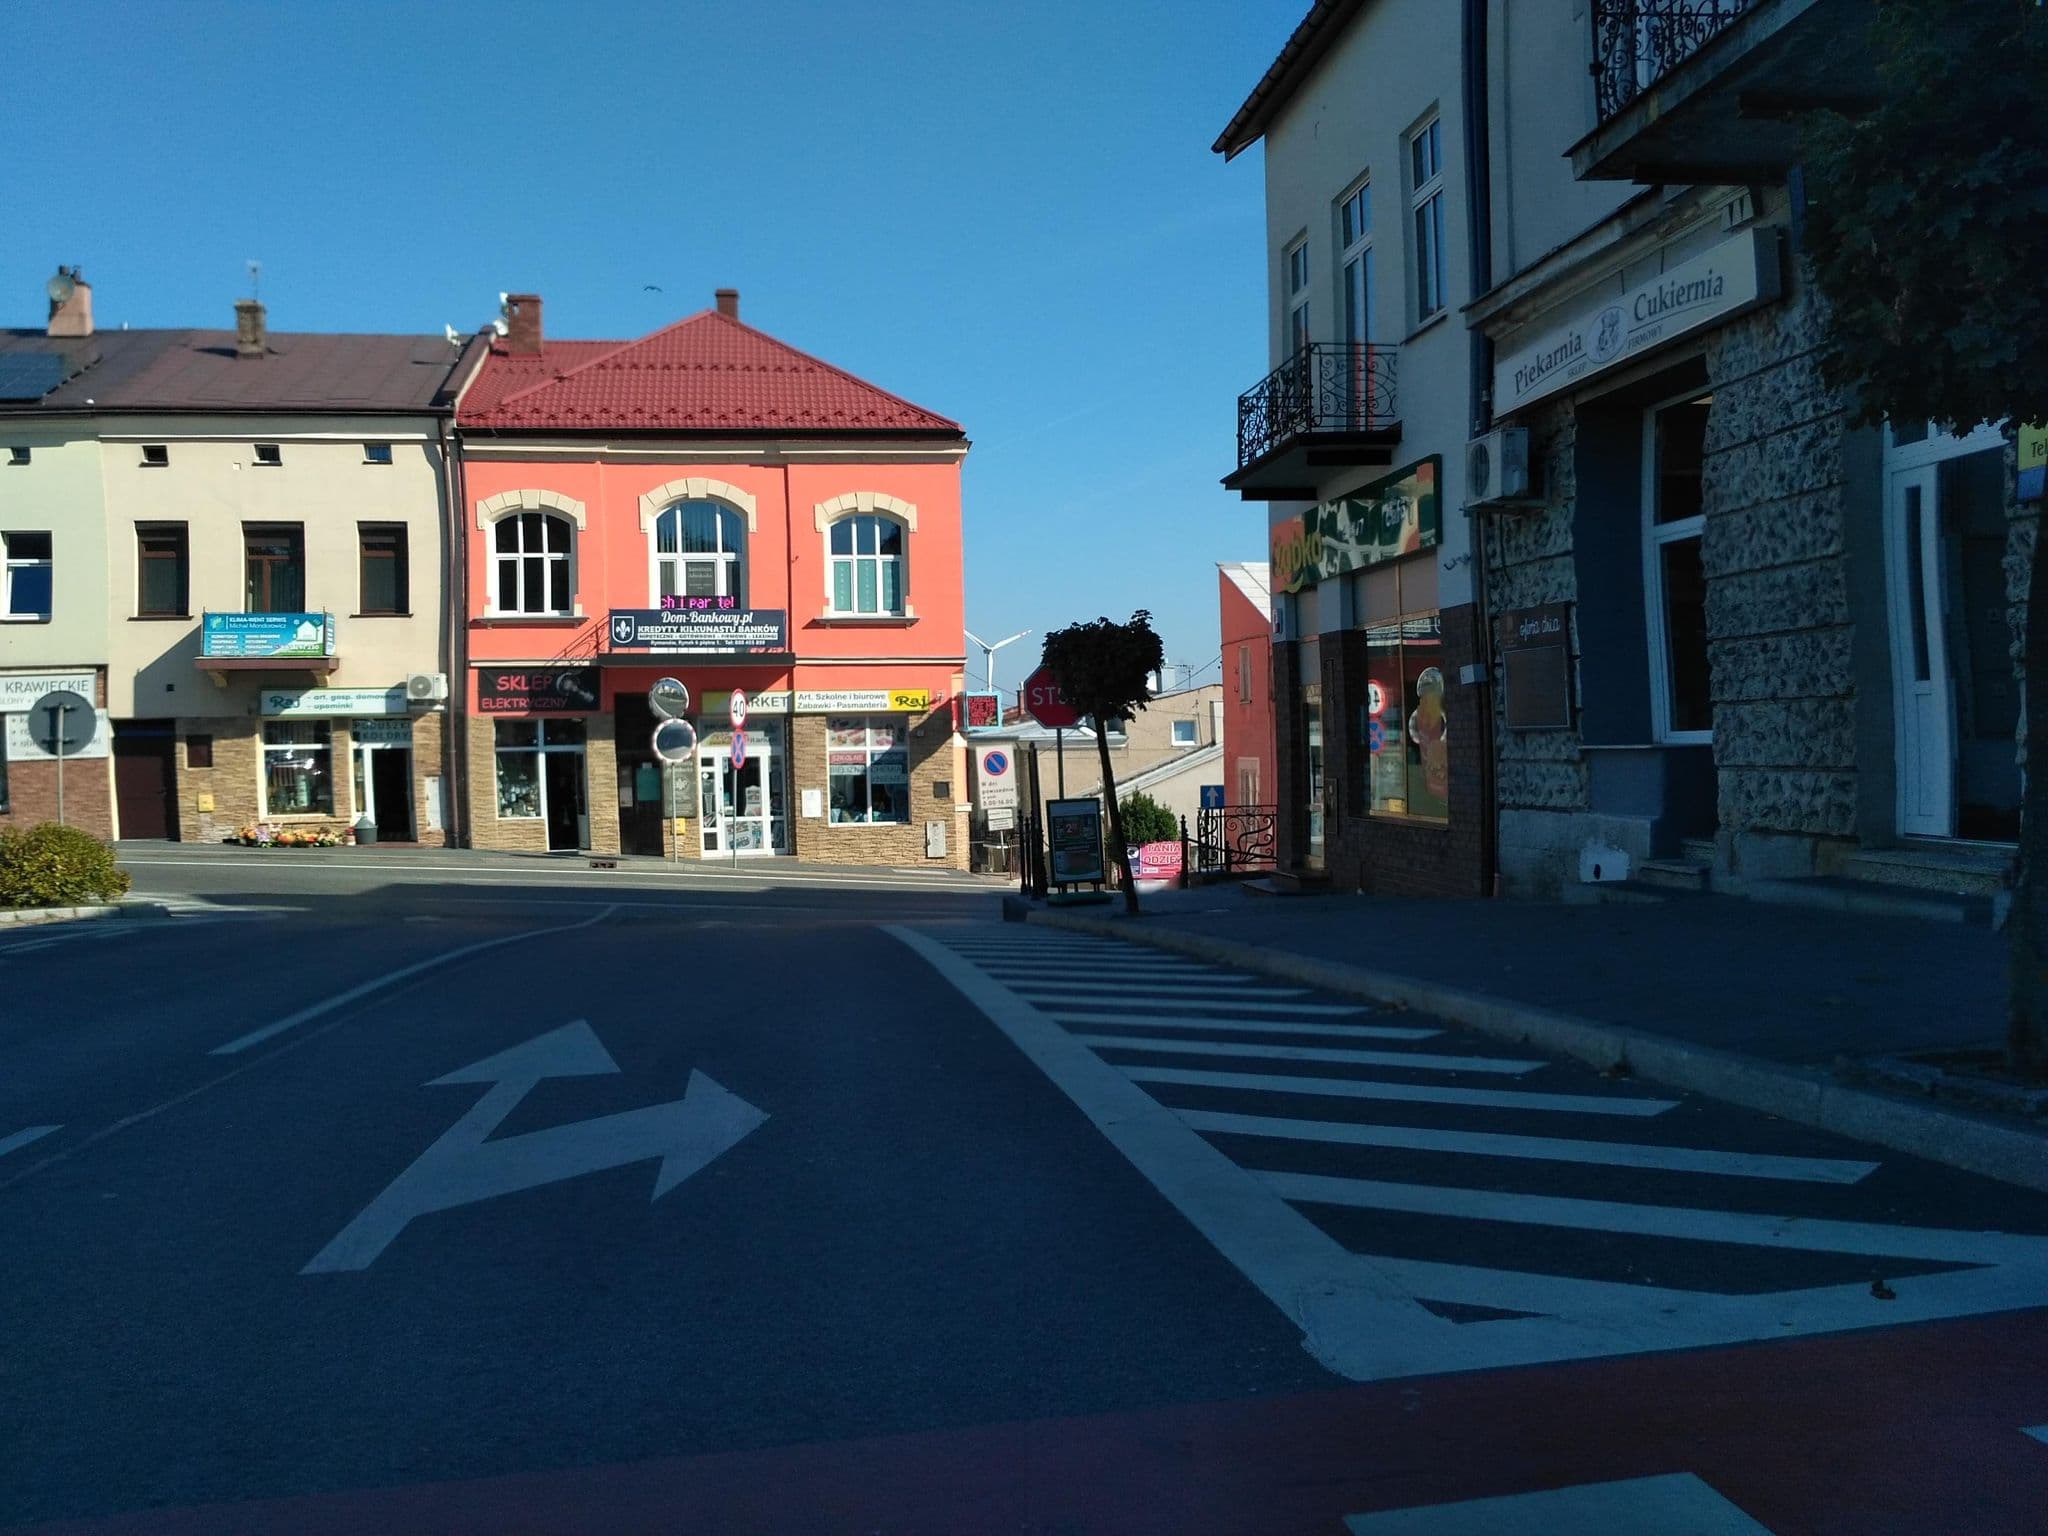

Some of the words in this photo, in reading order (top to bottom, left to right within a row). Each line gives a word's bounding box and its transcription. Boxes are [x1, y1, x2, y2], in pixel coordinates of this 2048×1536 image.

[1514, 331, 1582, 395] Piekarnia
[1634, 268, 1724, 322] Cukiernia
[1627, 325, 1664, 350] FIRMOWY
[661, 611, 753, 626] Dom-Bankowy.pl
[638, 625, 678, 633] KREDYTY
[680, 625, 736, 633] KILKUNASTU
[738, 623, 779, 633] BANKÓW
[5, 680, 89, 694] KRAWIECKIE
[496, 675, 554, 691] SKLEP
[269, 695, 301, 709] Raj
[481, 697, 568, 709] ELEKTRYCZNY
[745, 696, 787, 708] ARKET
[853, 692, 886, 700] biurowe
[895, 694, 928, 712] Raj
[314, 702, 354, 710] upominki
[733, 700, 745, 718] 40
[797, 701, 832, 710] Zabawki
[836, 701, 888, 709] Pasmanteria
[1148, 843, 1181, 852] TANIA
